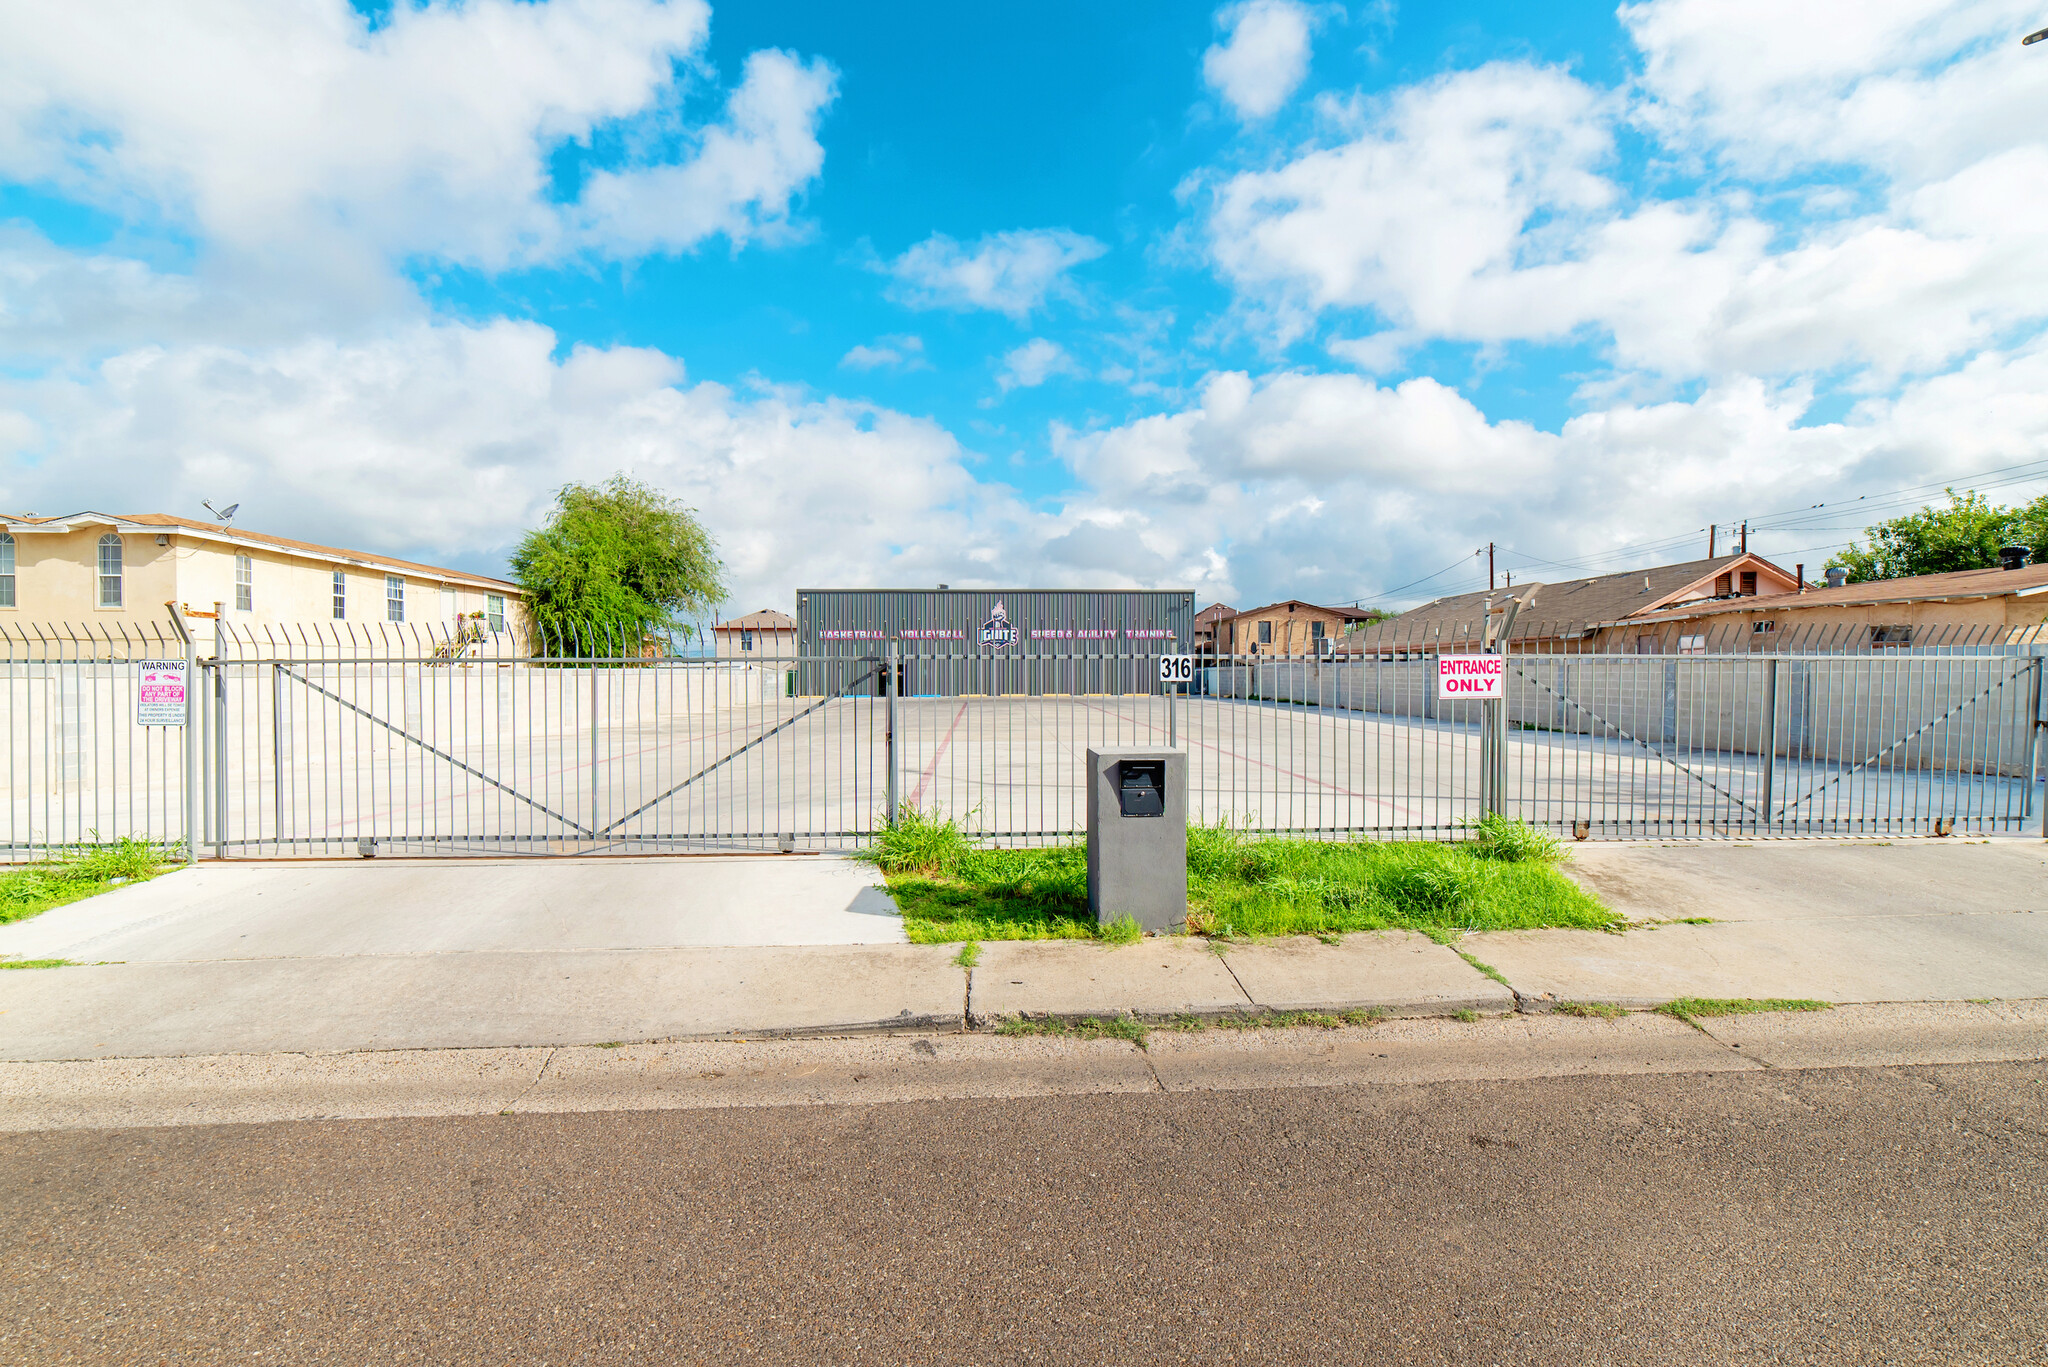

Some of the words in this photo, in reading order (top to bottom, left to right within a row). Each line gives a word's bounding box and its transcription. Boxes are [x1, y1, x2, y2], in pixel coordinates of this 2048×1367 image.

[819, 630, 886, 640] BASKETBALL
[900, 630, 964, 640] VOLLEYBALL
[1125, 630, 1173, 639] TRAINING
[141, 662, 185, 670] WARNING
[1161, 657, 1191, 679] 316
[1440, 659, 1501, 674] ENTRANCE
[1446, 679, 1495, 692] ONLY
